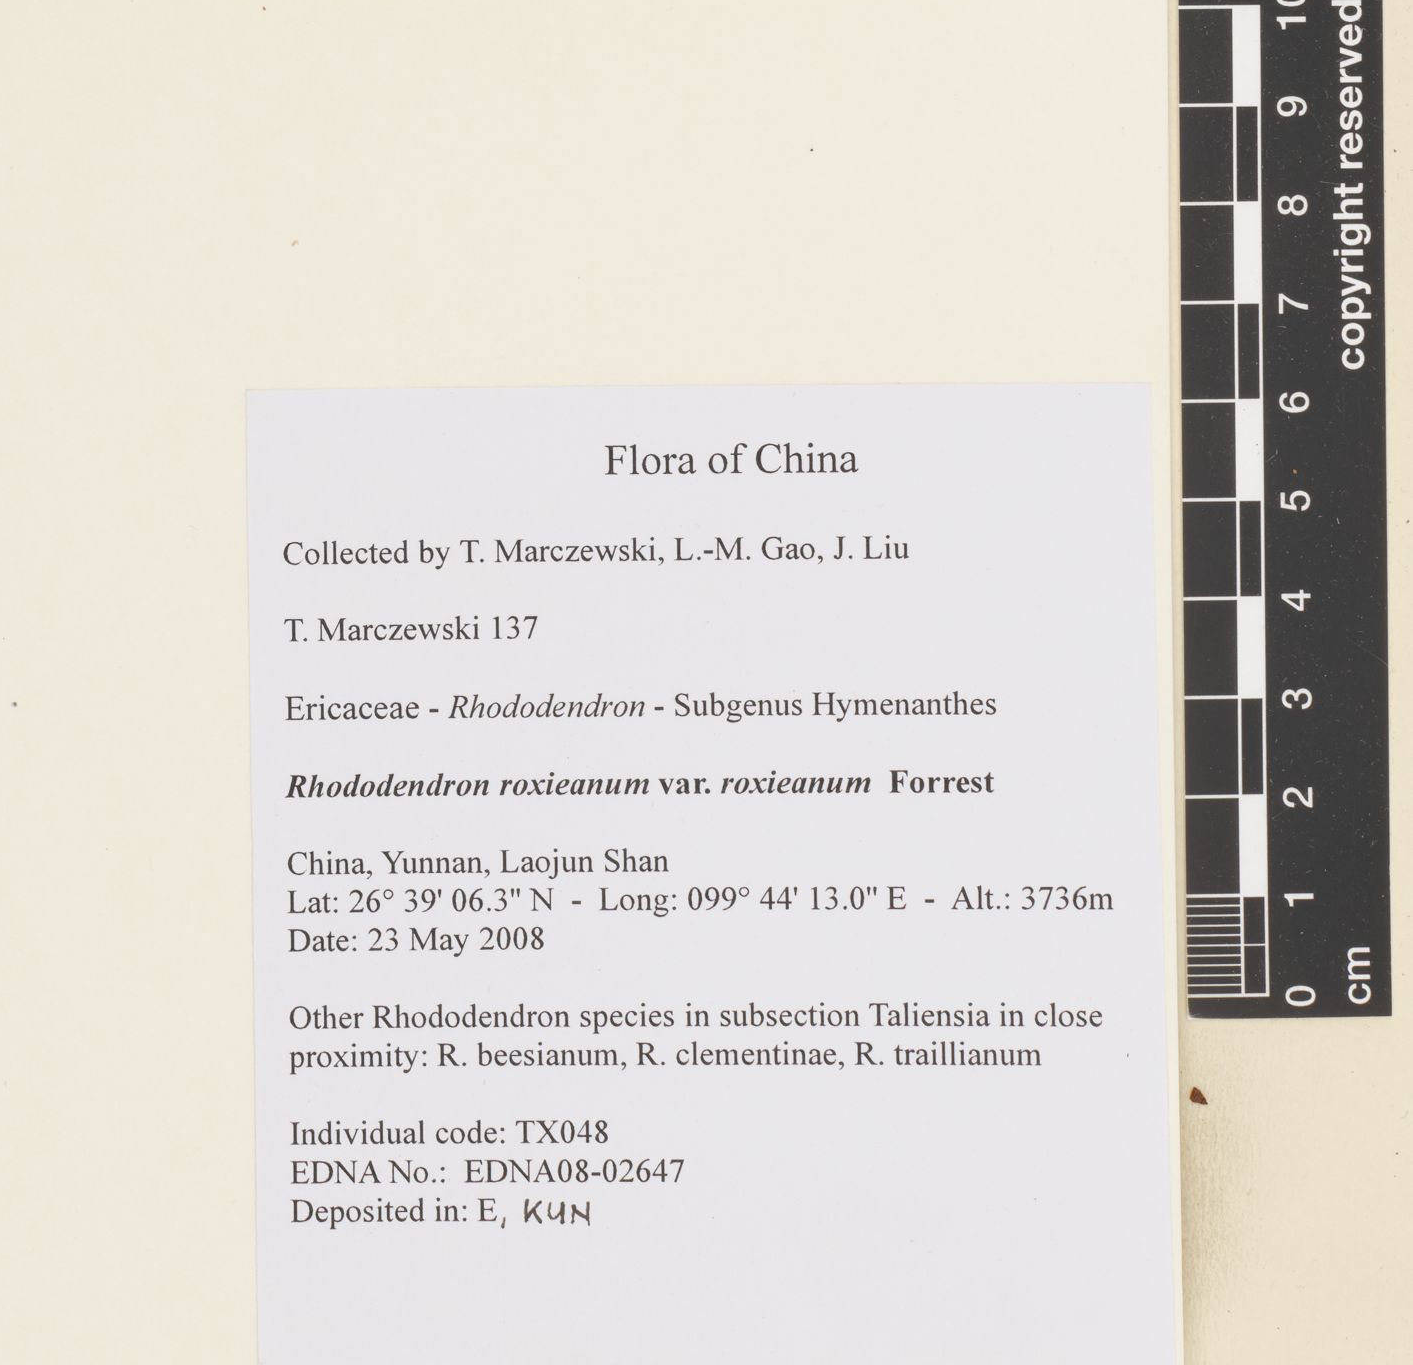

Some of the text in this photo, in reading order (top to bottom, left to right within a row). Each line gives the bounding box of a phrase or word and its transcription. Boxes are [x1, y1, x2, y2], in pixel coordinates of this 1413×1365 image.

[1276, 95, 1308, 118] 9
[1330, 0, 1372, 371] copyright reserved
[1276, 194, 1309, 217] 8
[1278, 292, 1309, 315] 7
[1278, 391, 1310, 414] 6
[604, 442, 859, 475] Flora of China
[1279, 490, 1311, 512] 5
[283, 534, 909, 570] Collected by T. Marczewski, L.-M. Gao, J. Liu
[1280, 589, 1312, 612] 4
[283, 615, 538, 642] T. Marczewski 137
[285, 694, 420, 721] Ericaceae
[448, 692, 645, 719] Rhododendron
[674, 692, 803, 723] Subgenus
[813, 690, 997, 723] Hymenanthes
[1281, 687, 1313, 710] 3
[285, 769, 995, 798] Rhododendron roxieanum var. roxieanum Forrest
[1282, 786, 1314, 809] 2
[287, 847, 669, 880] China, Yunnan, Laojun Shan
[288, 890, 338, 914] Lat:
[530, 887, 553, 912] N
[600, 887, 677, 918] Long:
[888, 886, 907, 910] E
[951, 884, 1010, 910] Alt.:
[1021, 885, 1114, 911] 3736m
[1283, 892, 1315, 908] 1
[288, 926, 545, 958] Date: 23 May 2008
[1346, 946, 1372, 1005] cm
[1284, 985, 1317, 1007] 0
[289, 1002, 1103, 1035] Other Rhododendron species in subsection Taliensia in close
[289, 1040, 1041, 1075] proximity: R. beesianum, R. clementinae, R. traillianum
[291, 1119, 609, 1146] Individual code: TX048
[292, 1158, 685, 1185] EDNA No.: EDNA08-02647
[291, 1197, 425, 1230] Deposited
[435, 1197, 467, 1222] in:
[523, 1198, 591, 1226] KUN
